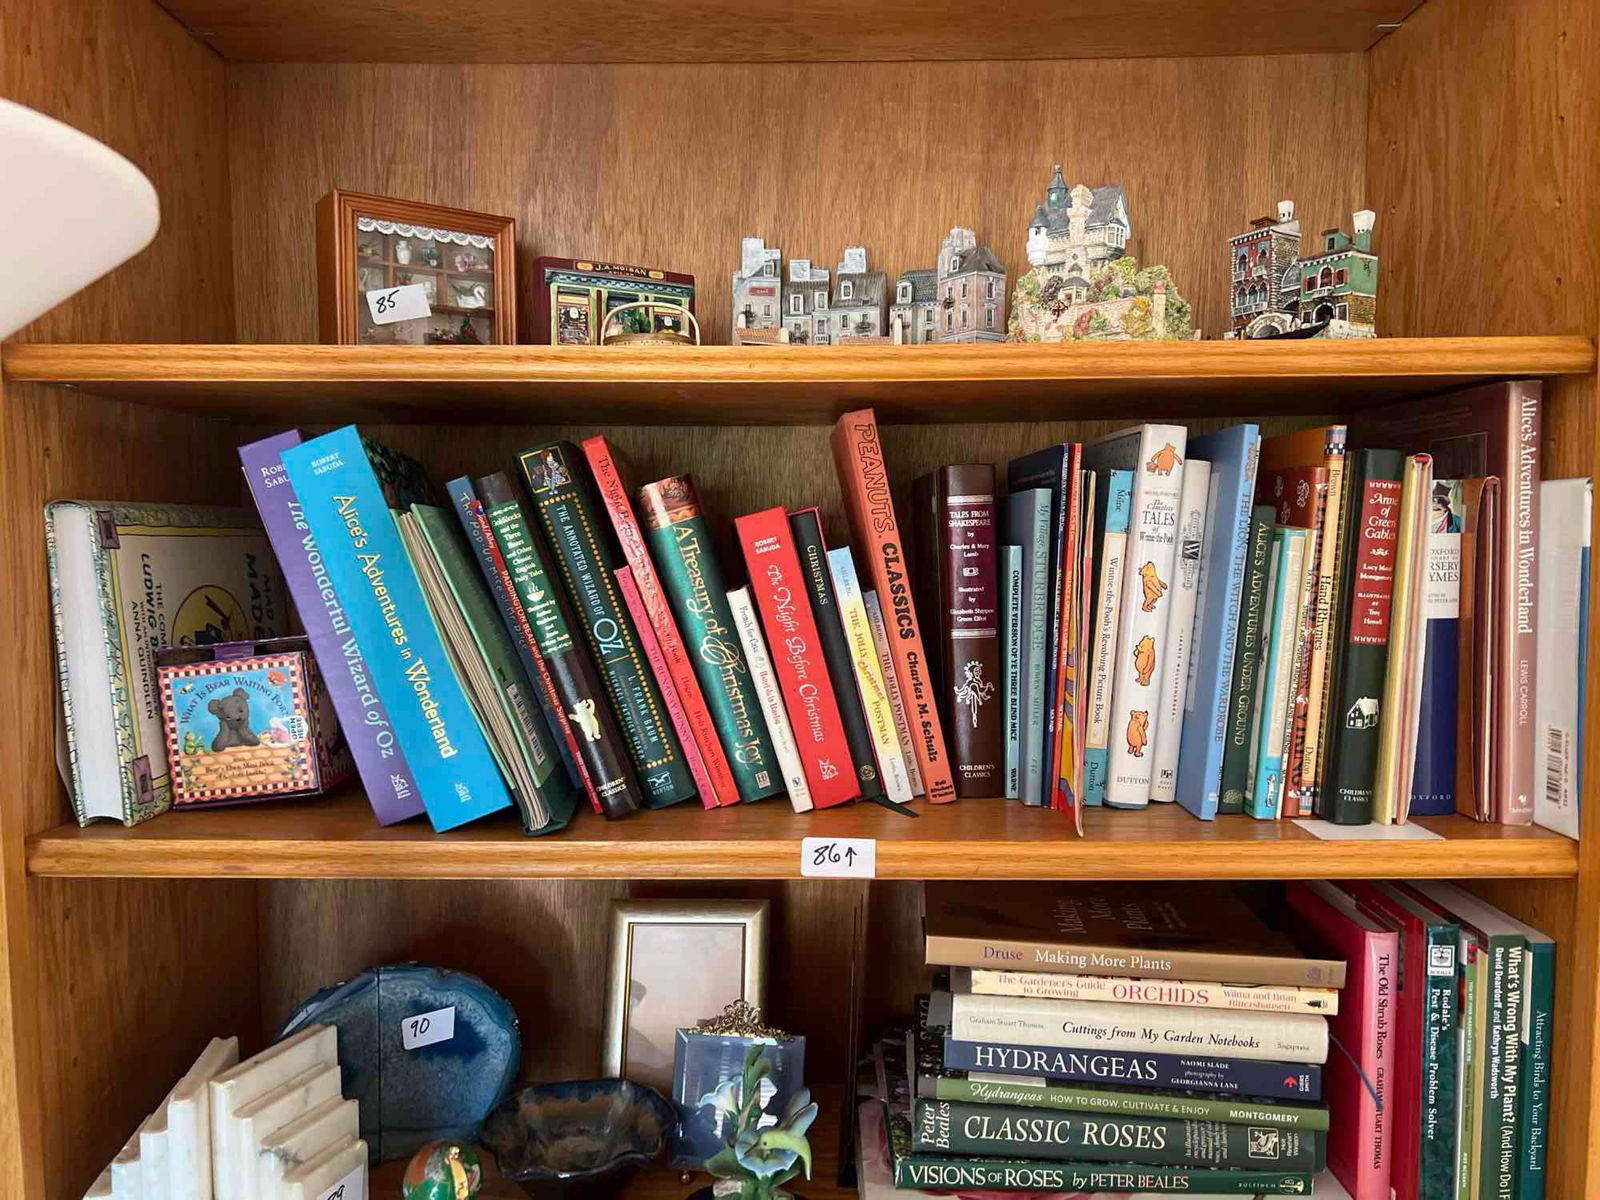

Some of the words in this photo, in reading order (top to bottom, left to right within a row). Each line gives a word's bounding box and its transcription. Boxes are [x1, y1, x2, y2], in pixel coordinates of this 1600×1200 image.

[375, 290, 401, 314] 85
[1520, 396, 1537, 442] Alice's
[1369, 492, 1399, 505] Anne
[1520, 443, 1537, 530] Adventures
[332, 495, 369, 548] Alice's
[948, 519, 992, 528] SHAKESPEARE
[949, 510, 969, 519] TALES
[970, 510, 990, 519] FROM
[1142, 511, 1176, 526] TALES
[1368, 515, 1396, 528] Green
[1380, 506, 1391, 516] of
[672, 525, 695, 543] A
[1519, 531, 1534, 544] in
[556, 504, 569, 524] THE
[563, 524, 588, 572] ANNOTATED
[581, 573, 601, 606] WIZARD
[593, 606, 606, 617] OF
[767, 564, 782, 586] The
[806, 545, 829, 605] CHRISTMAS
[141, 553, 158, 632] LUDWIG
[679, 537, 714, 620] Treasury
[881, 542, 916, 641] CLASSICS
[1012, 570, 1020, 611] COMPLETE
[1318, 575, 1332, 604] Hand
[1517, 545, 1535, 634] Wonderland
[357, 553, 408, 645] Adventures
[501, 570, 532, 621] PADDINGTON
[773, 586, 796, 633] Night
[1032, 551, 1049, 651] STURBRIDGE
[1226, 580, 1240, 620] WITCH
[1245, 568, 1268, 649] ADVENTURES
[703, 617, 729, 636] of
[848, 607, 861, 630] THE
[1011, 613, 1019, 647] VERSION
[1314, 606, 1329, 651] Rhymes
[593, 618, 625, 656] OZ
[853, 630, 869, 658] JOLLY
[1223, 621, 1236, 650] AND
[132, 601, 141, 642] ANNA
[138, 647, 154, 719] QUINDLEN
[400, 648, 412, 661] in
[785, 635, 808, 681] Before
[881, 650, 893, 672] THE
[1010, 648, 1018, 657] OF
[1098, 634, 1110, 674] Revolving
[1221, 654, 1231, 678] THE
[341, 638, 379, 707] Wizard
[886, 671, 900, 702] JOLLY
[906, 651, 924, 701] Charles
[1010, 671, 1018, 701] THREE
[1240, 651, 1257, 693] UNDER
[181, 701, 198, 724] WHAT
[205, 678, 230, 694] BEAR
[233, 676, 272, 697] WAITING
[700, 634, 755, 738] Christmas
[735, 737, 764, 770] Joy
[1094, 675, 1107, 706] Picture
[364, 709, 389, 727] of
[404, 658, 459, 760] Wonderland
[632, 688, 650, 717] FRANK
[641, 717, 660, 744] BAUM
[798, 682, 826, 743] Christmas
[871, 700, 890, 745] POSTMAN
[916, 703, 928, 720] M.
[1010, 702, 1018, 724] BLIND
[1093, 706, 1105, 724] Book
[1214, 679, 1230, 743] WARDROBE
[1233, 695, 1250, 746] GROUND
[1518, 689, 1528, 726] CARROLL
[894, 702, 911, 747] POSTMAN
[376, 730, 395, 758] Oz
[921, 719, 938, 763] Schulz
[1087, 761, 1099, 791] Dutton
[1116, 775, 1149, 785] DUTTON
[813, 842, 841, 866] 86
[983, 946, 1024, 961] Druse
[1035, 949, 1087, 968] Making
[1090, 953, 1126, 968] More
[1130, 956, 1172, 971] Plants
[1378, 954, 1390, 976] The
[1495, 947, 1505, 970] David
[1507, 946, 1522, 990] What's
[1019, 974, 1072, 988] Gardener's
[1076, 979, 1107, 990] Guide
[1036, 987, 1079, 999] Growing
[1112, 983, 1210, 1005] ORCHIDS
[1252, 991, 1271, 1001] and
[1378, 977, 1389, 996] Old
[1493, 970, 1504, 1009] Deardorff
[1376, 998, 1389, 1029] Shrub
[1430, 988, 1441, 1009] Pest
[1441, 989, 1452, 1032] Rodale's
[1502, 990, 1521, 1031] Wrong
[410, 1017, 431, 1038] 90
[969, 1015, 996, 1026] Graham
[1018, 1019, 1045, 1029] Thomas
[1430, 1012, 1441, 1022] &
[1492, 1009, 1501, 1024] and
[1062, 1021, 1108, 1040] Cuttings
[1107, 1025, 1136, 1041] from
[1141, 1028, 1160, 1044] My
[1164, 1030, 1204, 1045] Garden
[1207, 1033, 1261, 1049] Notebooks
[1375, 1031, 1388, 1060] Roses
[1429, 1026, 1440, 1061] Disease
[1490, 1025, 1502, 1056] Kathryn
[1504, 1033, 1519, 1064] With
[1532, 1010, 1548, 1060] Attracting
[975, 1046, 1158, 1080] HYDRANGEAS
[1180, 1059, 1205, 1067] NAOMI
[1206, 1061, 1230, 1070] SLADE
[1489, 1056, 1501, 1100] Wadsworth
[1501, 1065, 1517, 1083] My
[1533, 1062, 1546, 1088] Birds
[969, 1082, 1045, 1103] Hydrangeas
[1050, 1094, 1073, 1104] HOW
[1075, 1096, 1089, 1105] TO
[1089, 1097, 1121, 1109] GROW,
[1122, 1101, 1170, 1113] CULTIVATE
[1171, 1105, 1179, 1113] &
[1181, 1106, 1210, 1116] ENJOY
[1171, 1077, 1219, 1088] GEORGIANNA
[1219, 1081, 1239, 1090] LANE
[1428, 1062, 1439, 1105] Problem
[1532, 1090, 1542, 1100] to
[1229, 1108, 1299, 1124] MONTGOMERY
[1502, 1085, 1517, 1123] Plant?
[1531, 1103, 1543, 1125] Your
[921, 1104, 936, 1145] Peter
[935, 1101, 950, 1149] Beales
[963, 1114, 1071, 1144] CLASSIC
[1081, 1121, 1168, 1150] ROSES
[1427, 1107, 1438, 1140] Solver
[1500, 1125, 1514, 1149] (And
[1373, 1136, 1383, 1170] THOMAS
[1499, 1150, 1513, 1173] How
[1528, 1127, 1542, 1171] Backyard
[908, 1164, 987, 1185] VISIONS
[987, 1172, 1003, 1183] OF
[1004, 1168, 1064, 1188] ROSES
[1072, 1172, 1089, 1189] by
[1090, 1173, 1135, 1188] PETER
[1137, 1173, 1190, 1190] BEALES
[1499, 1173, 1512, 1188] Do
